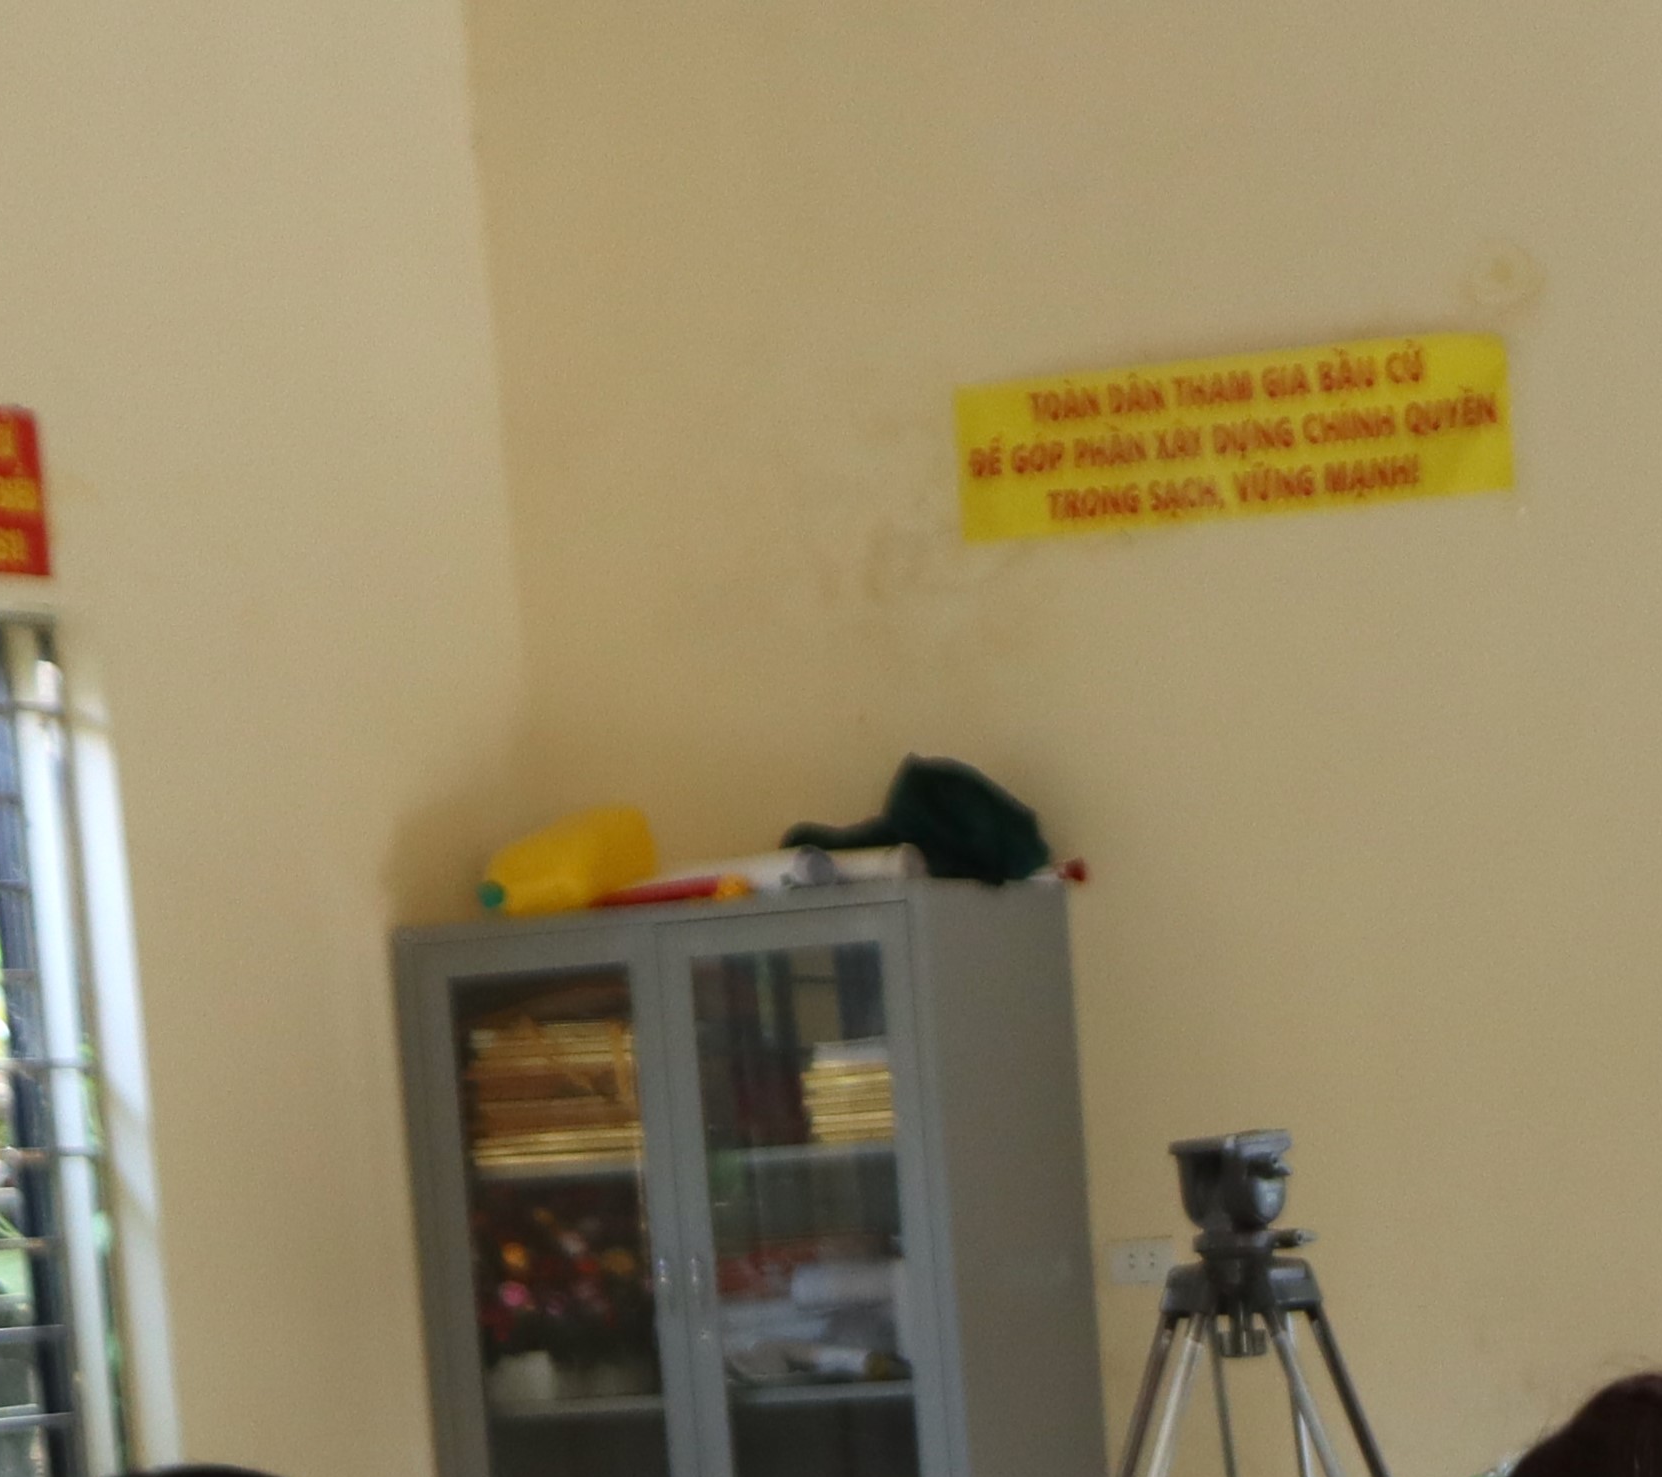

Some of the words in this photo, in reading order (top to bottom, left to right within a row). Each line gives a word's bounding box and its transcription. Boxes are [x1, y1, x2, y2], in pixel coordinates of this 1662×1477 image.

[1027, 379, 1100, 422] TOÀN
[1107, 372, 1164, 415] DÂN
[1172, 368, 1254, 407] THAM
[1261, 363, 1310, 400] GIA
[1317, 347, 1376, 392] BẦU
[1074, 421, 1146, 468] PHẦN
[1153, 419, 1201, 460] XÂY
[1212, 415, 1295, 459] DỰNG
[1404, 384, 1497, 434] QUYỀN
[1047, 484, 1142, 520] TRONG
